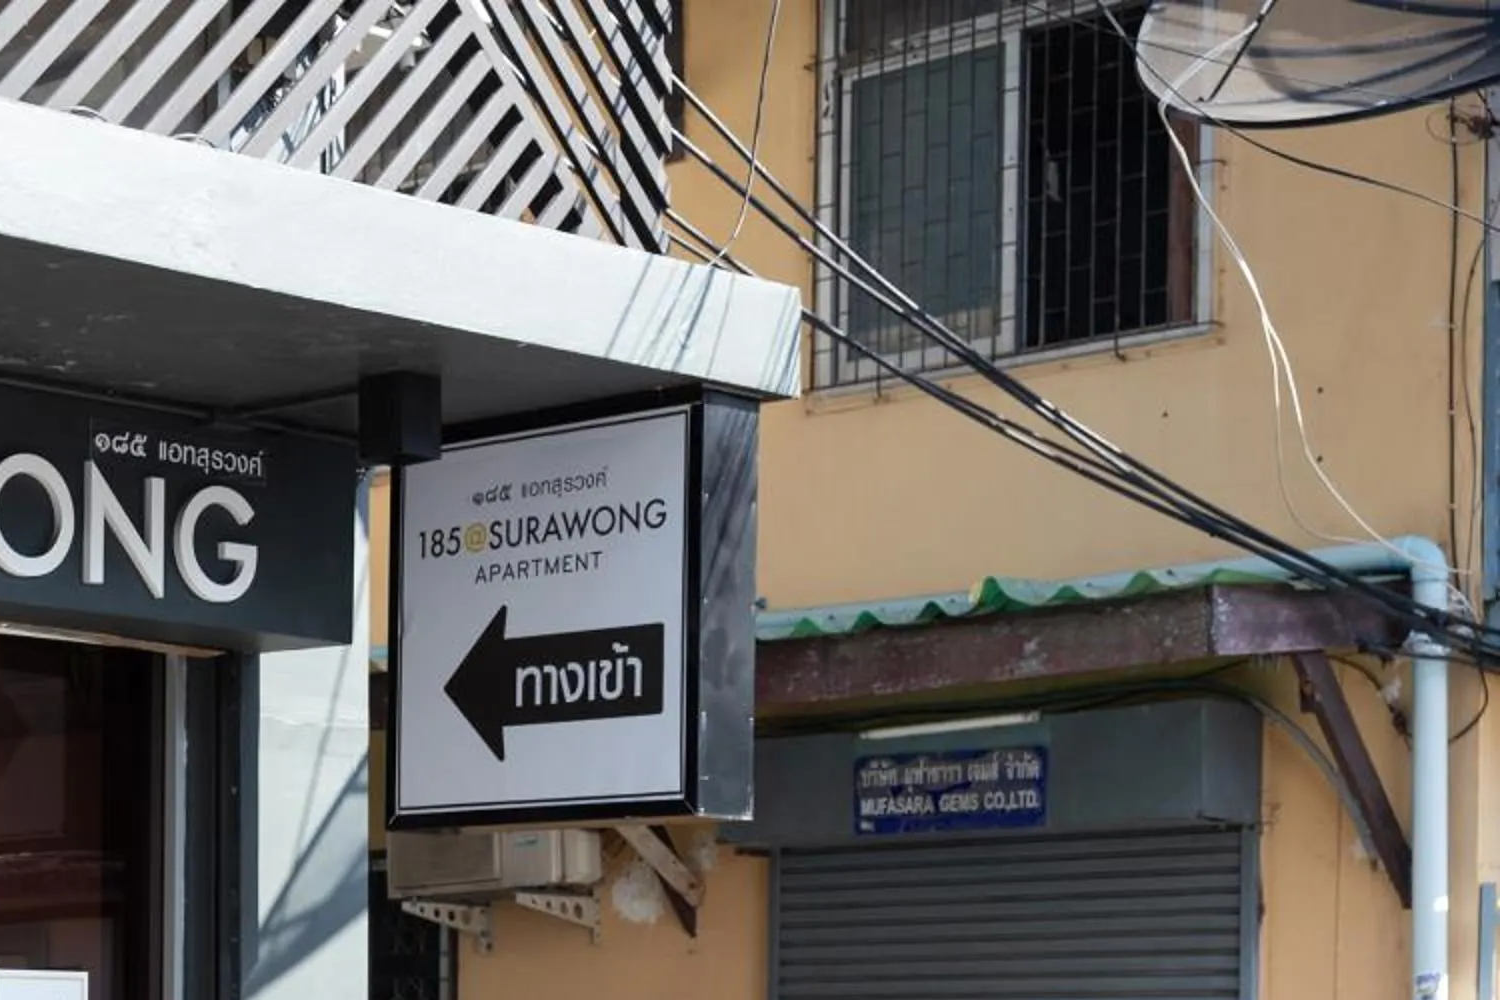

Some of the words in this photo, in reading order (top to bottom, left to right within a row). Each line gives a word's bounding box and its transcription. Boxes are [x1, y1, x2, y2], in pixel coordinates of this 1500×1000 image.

[94, 431, 148, 457] ๑๘๕
[419, 498, 668, 559] 185@SURAWONG
[474, 551, 603, 585] APARTMENT
[515, 642, 643, 708] ทางเข้า
[860, 795, 934, 816] MUFASARA
[938, 792, 980, 812] GEMS
